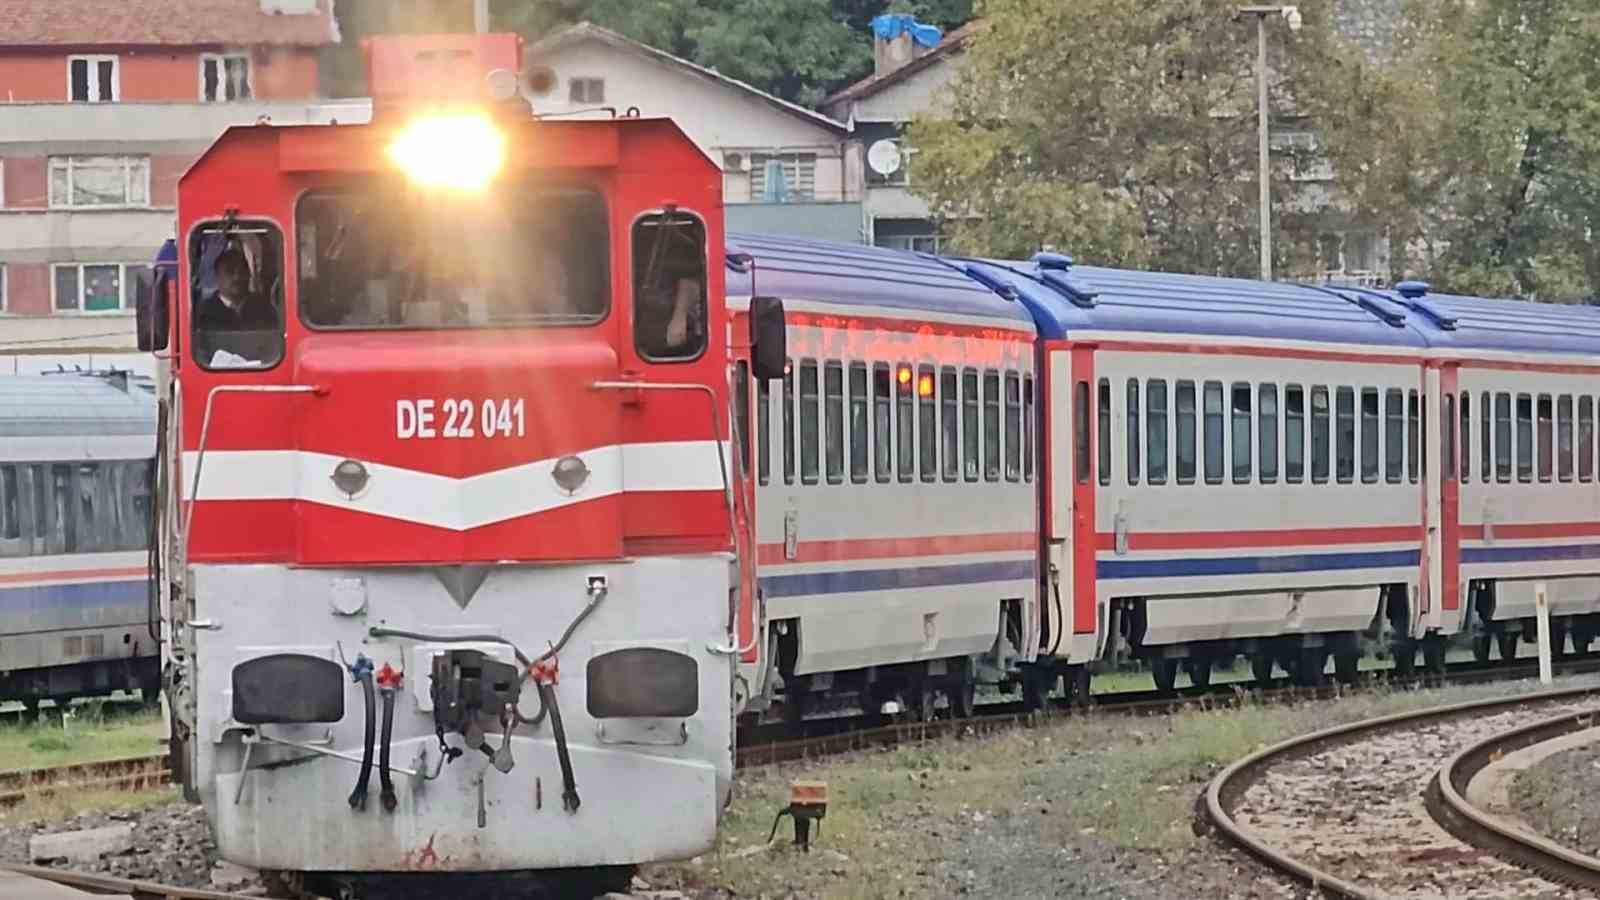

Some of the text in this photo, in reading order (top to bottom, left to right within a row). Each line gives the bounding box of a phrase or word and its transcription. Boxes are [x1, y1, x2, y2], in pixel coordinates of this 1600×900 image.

[396, 398, 525, 439] DE 22 041
